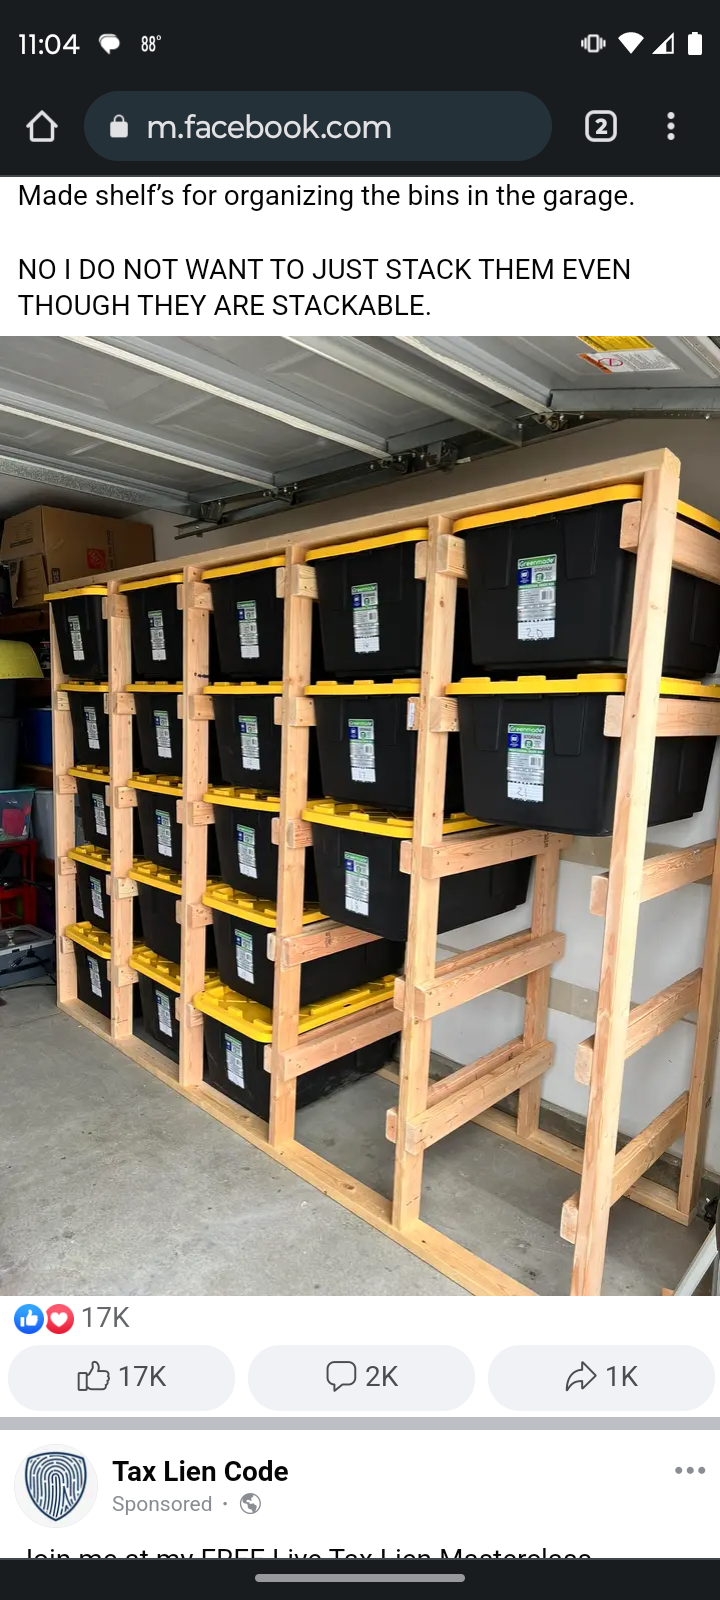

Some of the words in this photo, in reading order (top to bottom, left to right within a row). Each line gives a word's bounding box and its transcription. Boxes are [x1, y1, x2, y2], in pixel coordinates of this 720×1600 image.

[19, 33, 80, 56] 11:04
[141, 35, 162, 53] 88°
[148, 114, 391, 140] m.facebook.com
[594, 118, 608, 135] 2
[20, 184, 87, 205] Made
[96, 184, 173, 205] shelf’s
[182, 184, 217, 205] for
[225, 185, 352, 211] organizing
[361, 184, 400, 205] the
[409, 184, 459, 205] bins
[469, 185, 487, 205] in
[496, 184, 535, 205] the
[544, 190, 634, 211] garage.
[19, 259, 56, 279] NO
[65, 259, 70, 279] I
[79, 259, 115, 279] DO
[124, 259, 178, 279] NOT
[186, 259, 263, 279] WANT
[270, 259, 305, 279] TO
[312, 259, 378, 279] JUST
[386, 259, 471, 279] STACK
[479, 259, 553, 279] THEM
[563, 259, 630, 279] EVEN
[18, 295, 129, 315] THOUGH
[138, 295, 206, 315] THEY
[214, 295, 264, 315] ARE
[273, 295, 431, 315] STACKABLE.
[82, 1307, 130, 1328] 17K
[120, 1366, 166, 1386] 17K
[366, 1366, 398, 1386] 2K
[606, 1366, 639, 1386] 1K
[112, 1461, 156, 1482] Tax
[164, 1460, 216, 1482] Lien
[225, 1460, 289, 1482] Code
[112, 1495, 213, 1516] Sponsored
